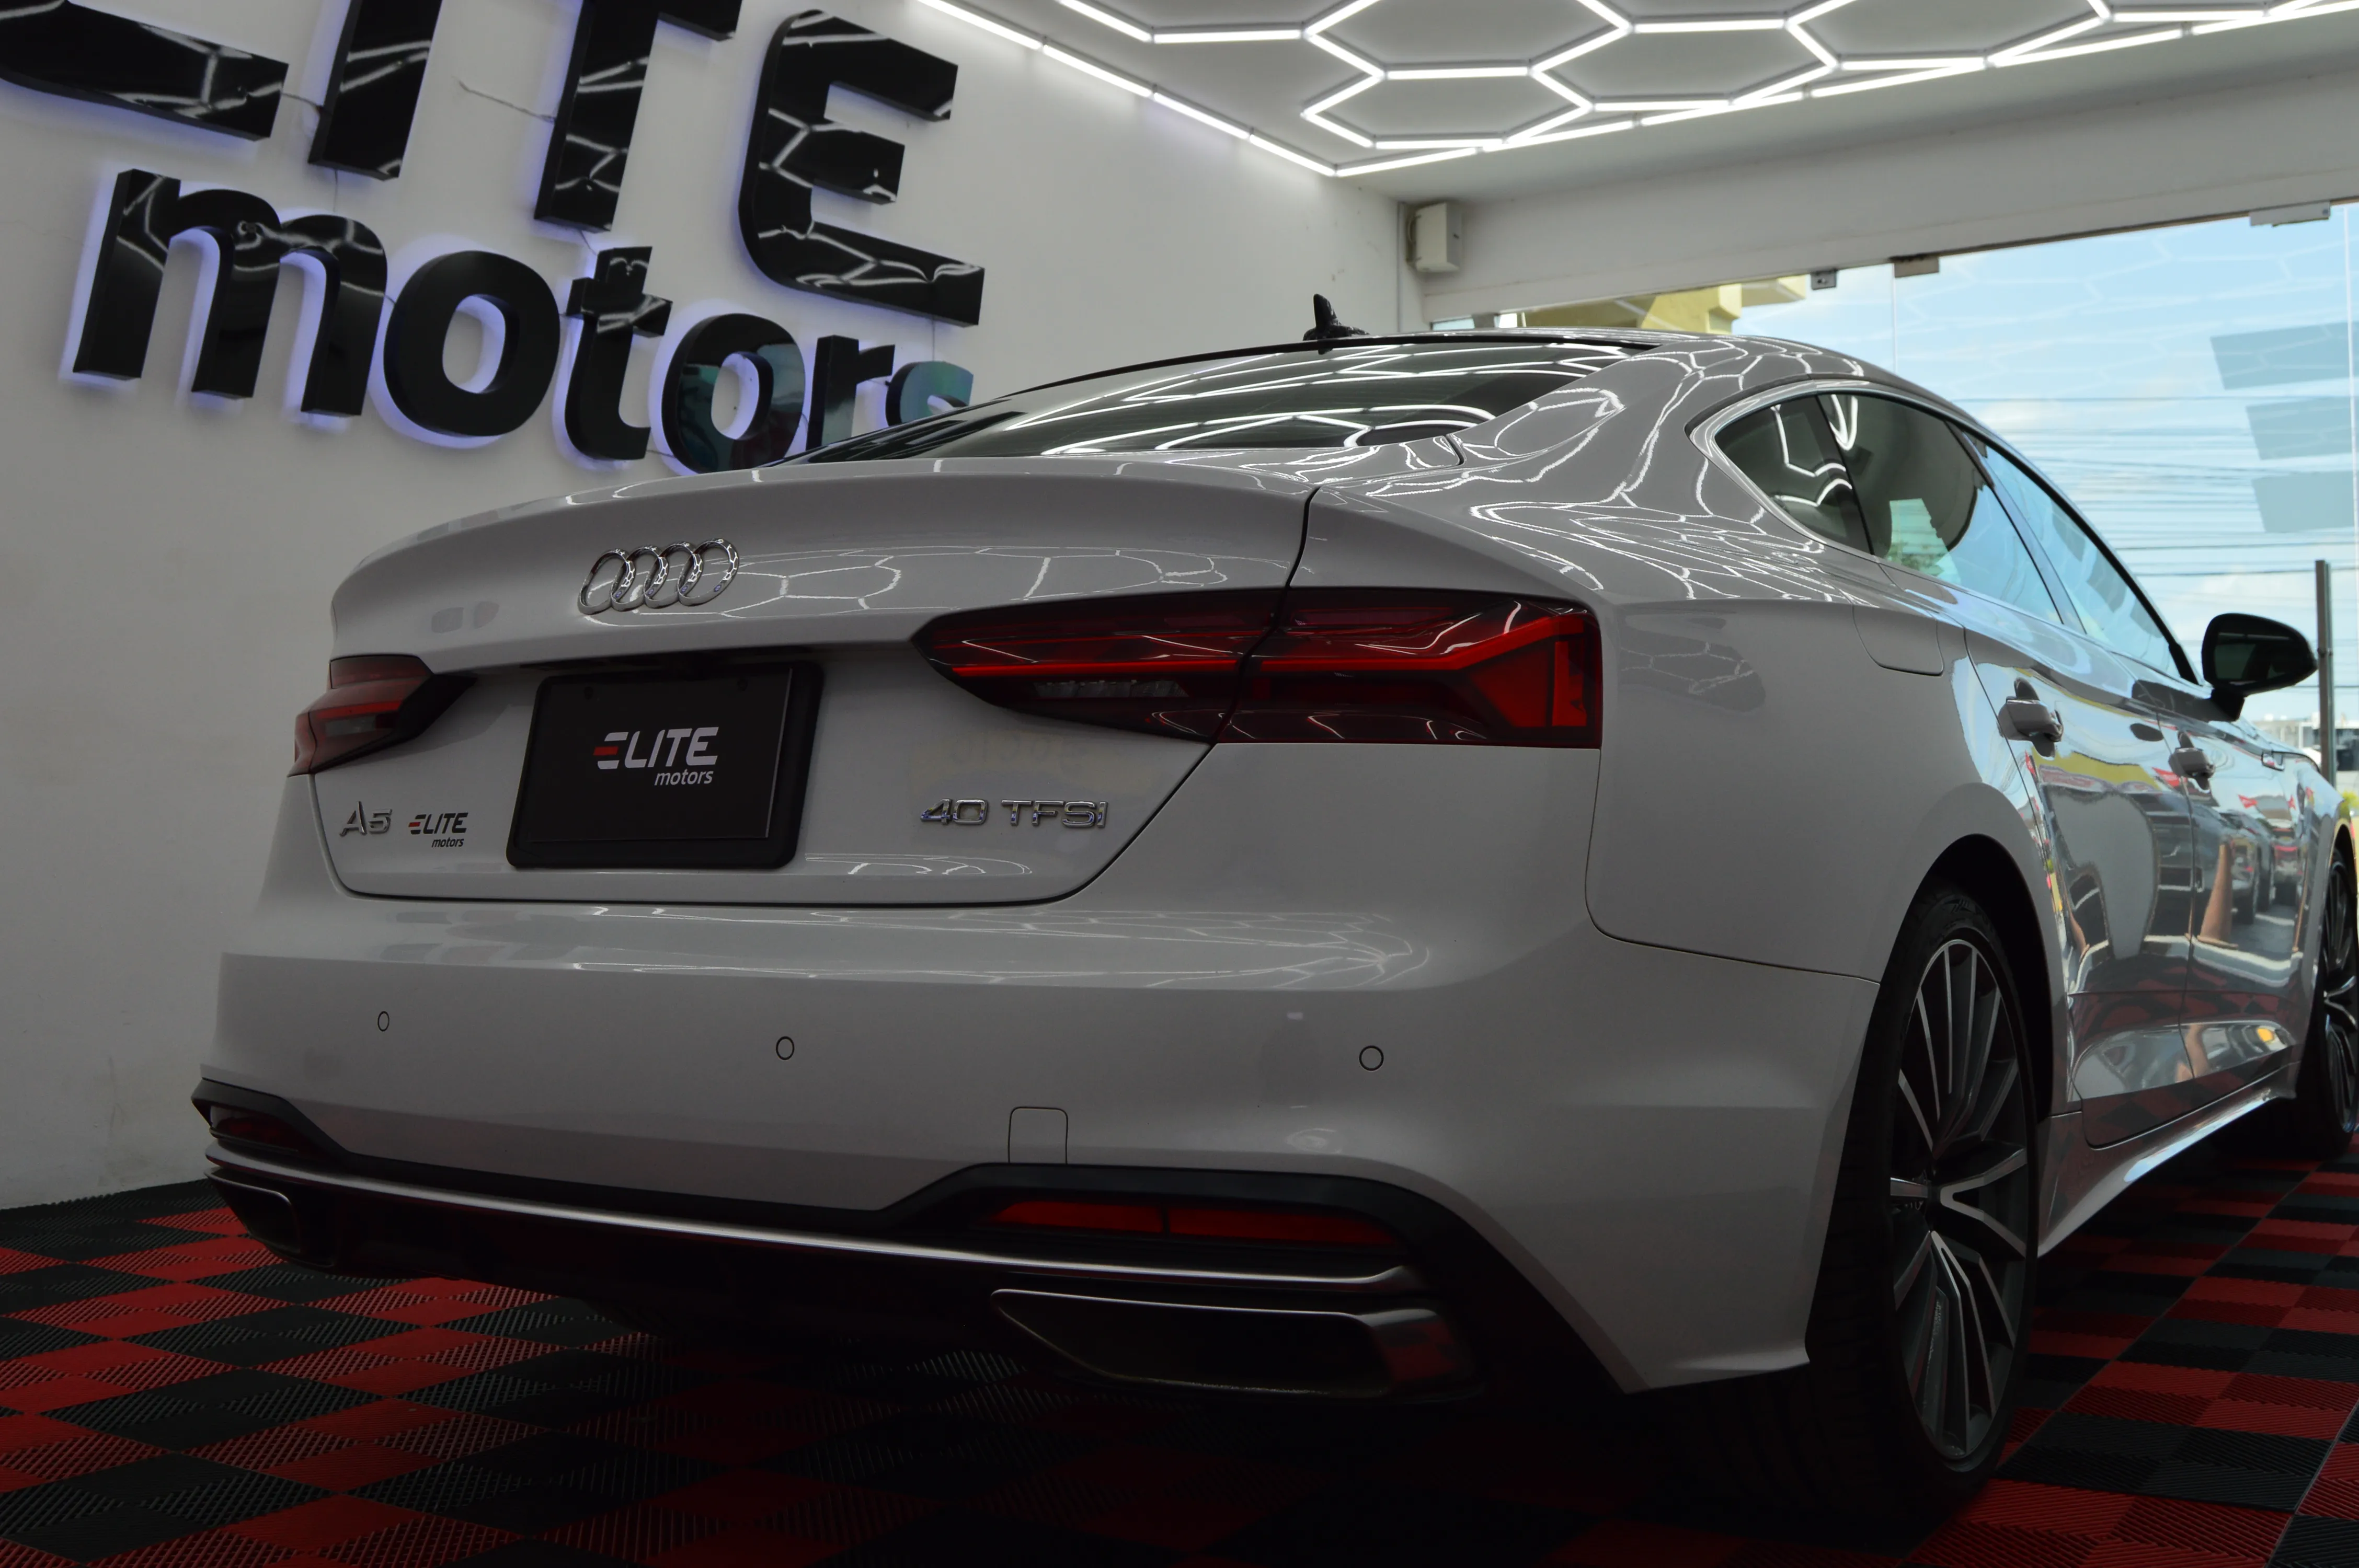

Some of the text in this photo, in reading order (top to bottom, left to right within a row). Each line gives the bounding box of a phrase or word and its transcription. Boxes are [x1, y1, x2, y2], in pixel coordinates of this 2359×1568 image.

[593, 727, 719, 770] ELITE
[654, 768, 714, 786] motors
[339, 801, 393, 837] A5
[408, 812, 468, 835] ELITE
[920, 798, 1108, 828] 40 TFSI
[431, 837, 465, 848] motors
